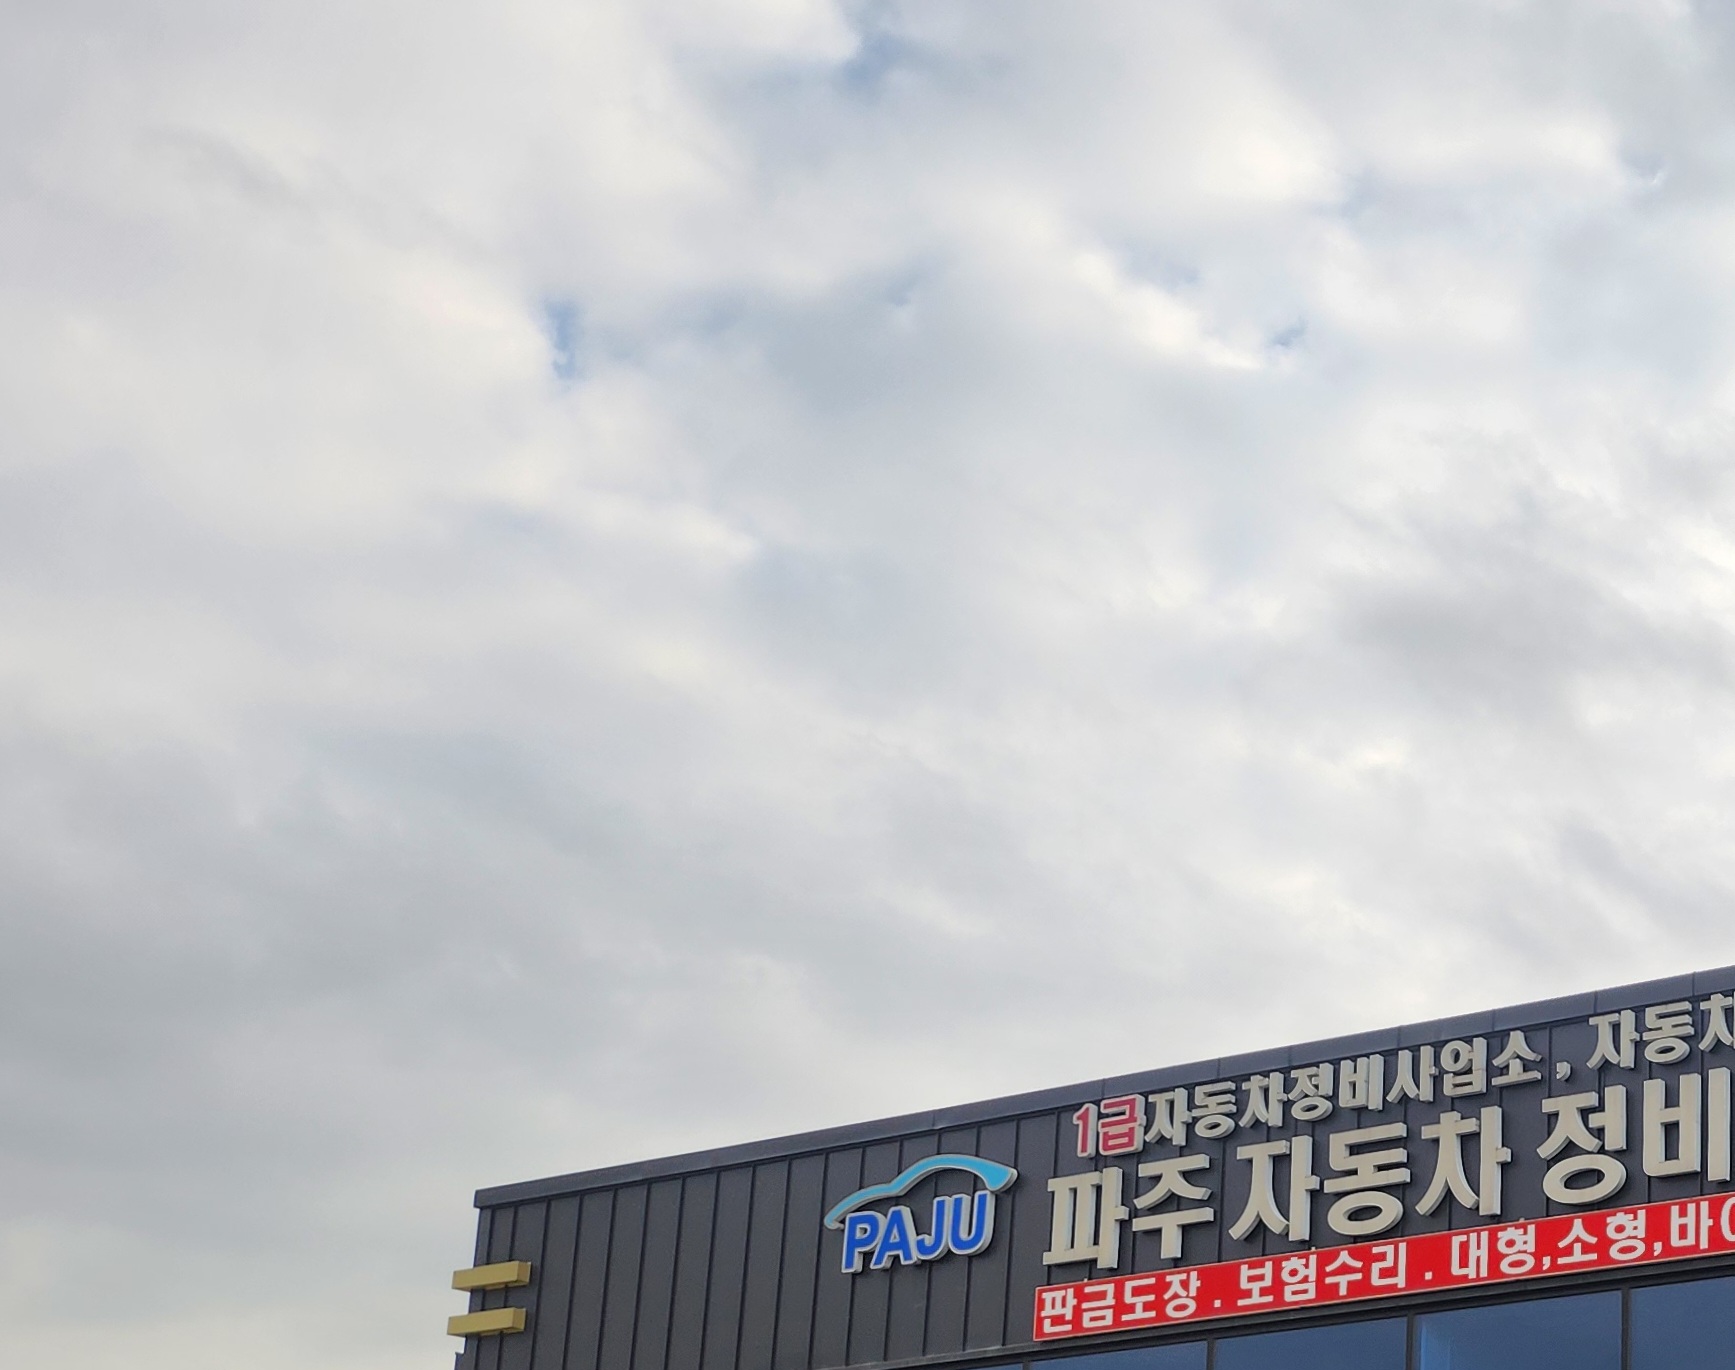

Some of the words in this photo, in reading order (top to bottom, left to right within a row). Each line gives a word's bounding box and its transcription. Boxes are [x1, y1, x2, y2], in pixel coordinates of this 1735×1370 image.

[1043, 1154, 1215, 1269] 파주
[1229, 1105, 1511, 1241] 자동차
[1536, 1067, 1731, 1205] 정비
[841, 1190, 995, 1274] PAJU
[1040, 1270, 1201, 1334] 판금도장
[1236, 1242, 1407, 1307] 보험수리
